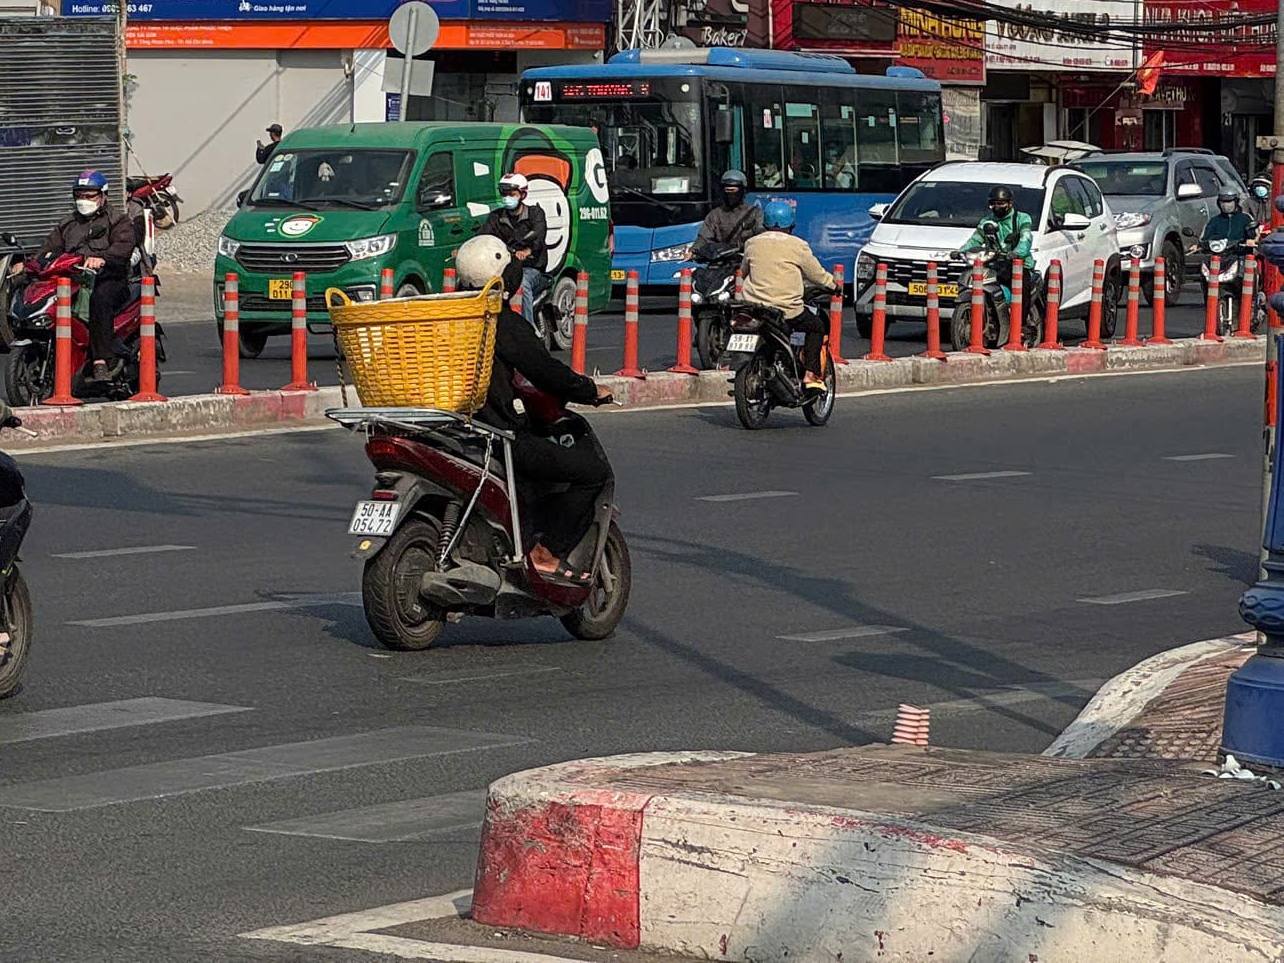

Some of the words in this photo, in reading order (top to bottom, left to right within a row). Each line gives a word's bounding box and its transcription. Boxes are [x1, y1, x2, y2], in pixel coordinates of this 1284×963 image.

[72, 4, 101, 13] Hotline:
[138, 4, 153, 13] 467
[253, 5, 268, 13] Giao
[536, 84, 552, 99] 141
[360, 504, 392, 518] 50-AA
